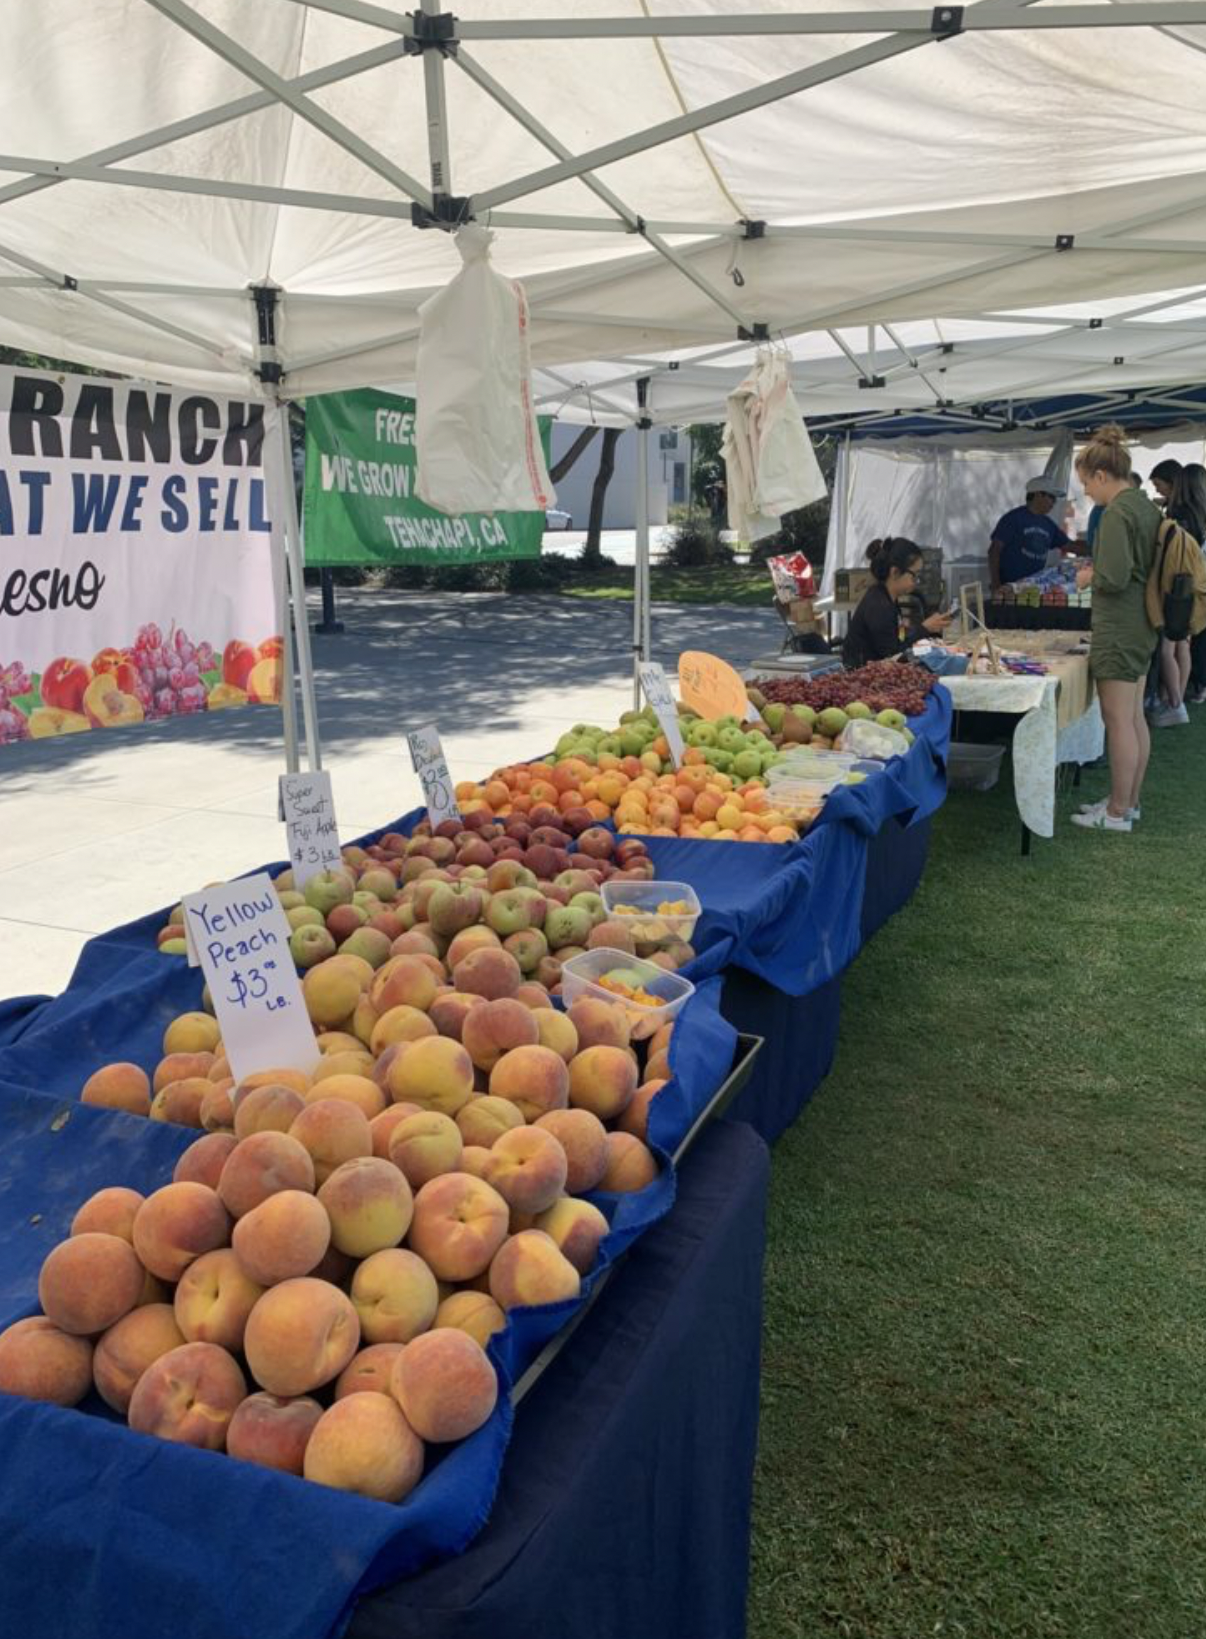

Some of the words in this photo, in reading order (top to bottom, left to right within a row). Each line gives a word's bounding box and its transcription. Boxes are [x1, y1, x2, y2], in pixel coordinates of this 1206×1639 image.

[9, 375, 265, 467] RANCH
[321, 454, 358, 493] WE
[357, 460, 409, 498] GROW
[71, 473, 148, 534] WE
[161, 475, 272, 533] SELL
[480, 517, 508, 546] CA
[190, 892, 274, 936] Yellow
[208, 928, 277, 968] Peach
